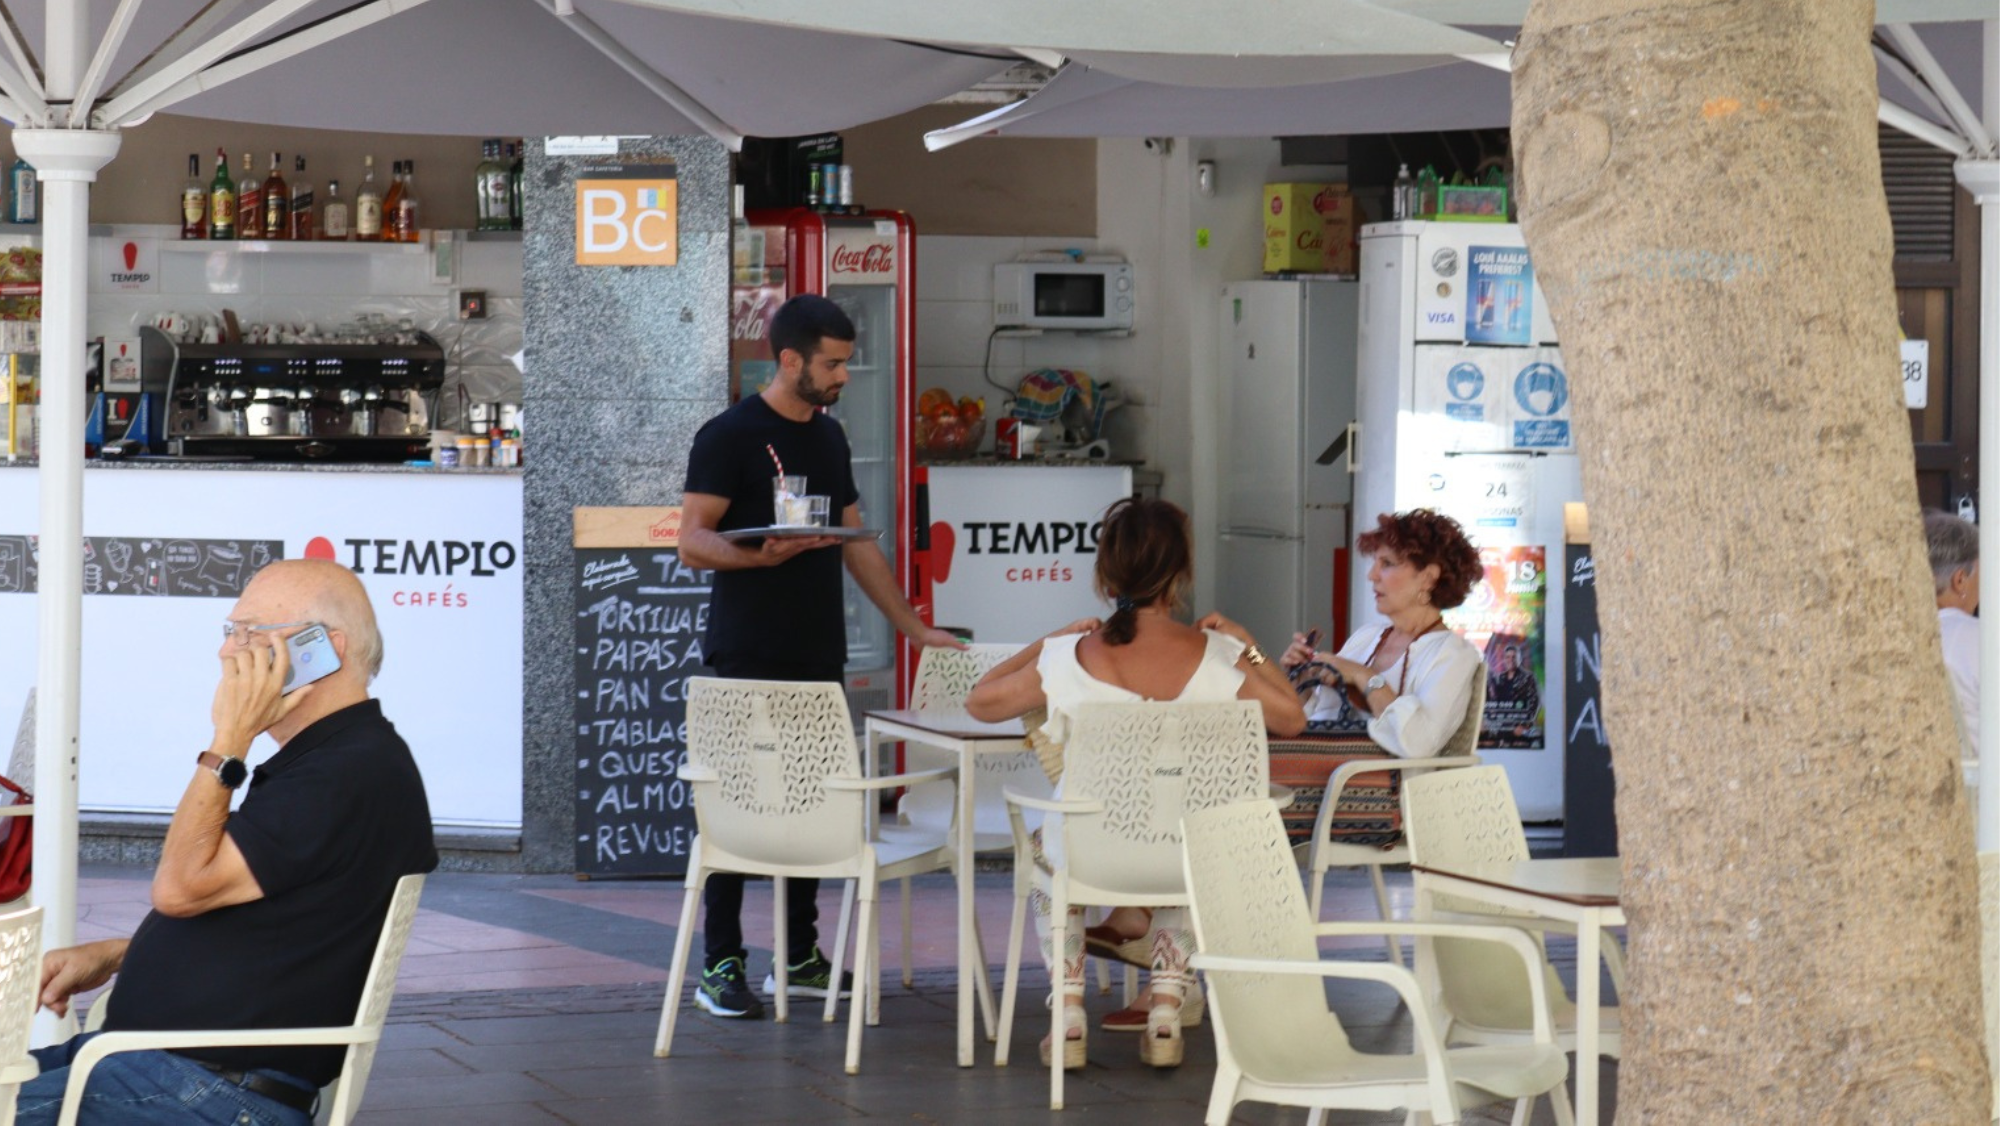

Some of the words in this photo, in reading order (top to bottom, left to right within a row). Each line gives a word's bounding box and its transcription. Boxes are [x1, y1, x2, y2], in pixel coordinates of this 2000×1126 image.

[110, 273, 151, 282] TEMPLO
[1428, 312, 1455, 323] VISA
[1485, 482, 1508, 498] 24
[345, 539, 516, 576] TEMPLO
[1006, 560, 1073, 582] CAFÉS
[1506, 561, 1537, 582] 18
[393, 584, 468, 608] CAFÉS
[593, 638, 678, 671] PAPAS
[595, 677, 650, 712] PAN
